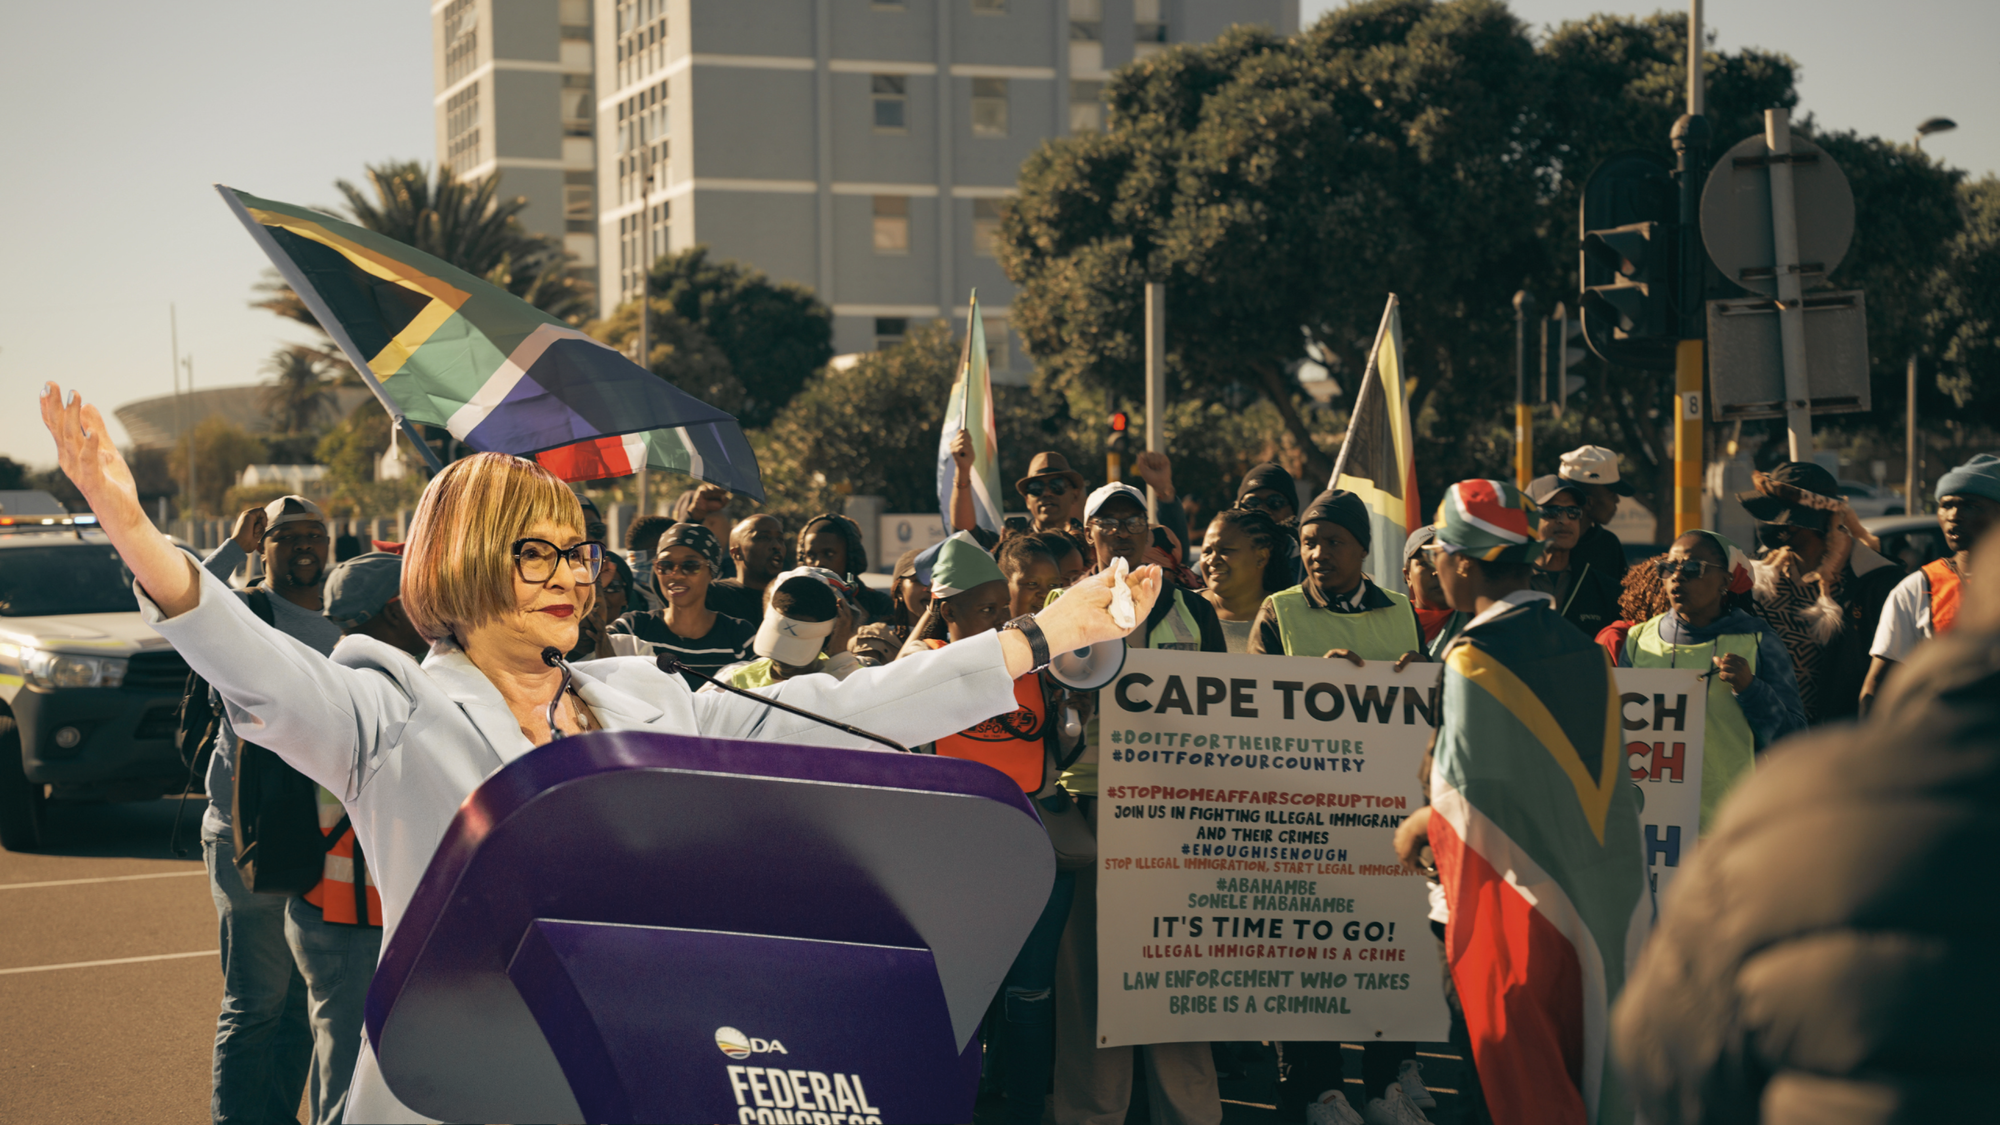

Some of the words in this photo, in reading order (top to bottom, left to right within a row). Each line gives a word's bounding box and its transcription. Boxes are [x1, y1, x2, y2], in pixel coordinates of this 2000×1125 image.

[1690, 395, 1699, 415] 8
[1115, 673, 1258, 718] CAPE
[1272, 680, 1437, 728] TOWN
[1620, 692, 1688, 731] CH
[1110, 729, 1364, 755] #DOITFORTHEIRFUTURE
[1112, 749, 1365, 772] #DOITFORYOURCOUNTRY
[1626, 741, 1686, 783] CH
[1107, 785, 1407, 810] #STOPHOMEAFFAIRSCORRUPTION
[1115, 805, 1144, 818] JOIN
[1148, 805, 1166, 818] US
[1171, 806, 1185, 819] IN
[1190, 807, 1260, 822] FIGHTING
[1265, 811, 1324, 825] ILLEGAL
[1196, 826, 1226, 841] AND
[1232, 828, 1272, 843] THEIR
[1278, 830, 1329, 844] CRIMES
[1182, 844, 1347, 861] #ENOUGHISENOUGH
[1105, 857, 1132, 870] STOP
[1136, 857, 1180, 869] ILLEGAL
[1184, 858, 1269, 872] IMMIGRATION,
[1274, 861, 1314, 874] START
[1318, 863, 1355, 875] LEGAL
[1217, 878, 1316, 895] #ABAHAMBE
[1188, 893, 1248, 909] SONELE
[1253, 895, 1354, 913] MABAHAMBE
[1154, 916, 1202, 937] IT'S
[1213, 917, 1283, 938] TIME
[1293, 919, 1333, 940] TO
[1343, 921, 1395, 942] GO!
[1143, 944, 1202, 958] ILLEGAL
[1209, 944, 1317, 959] IMMIGRATION
[1323, 948, 1337, 960] IS
[1343, 948, 1352, 960] A
[1359, 948, 1405, 961] CRIME
[1124, 972, 1160, 990] LAW
[1166, 969, 1294, 988] ENFORCEMENT
[1301, 971, 1347, 989] WHO
[1354, 973, 1410, 990] TAKES
[1170, 995, 1217, 1015] BRIBE
[1223, 995, 1239, 1013] IS
[1245, 995, 1257, 1013] A
[1264, 995, 1351, 1014] CRIMINAL
[750, 1037, 788, 1054] DA
[726, 1065, 881, 1115] FEDERAL
